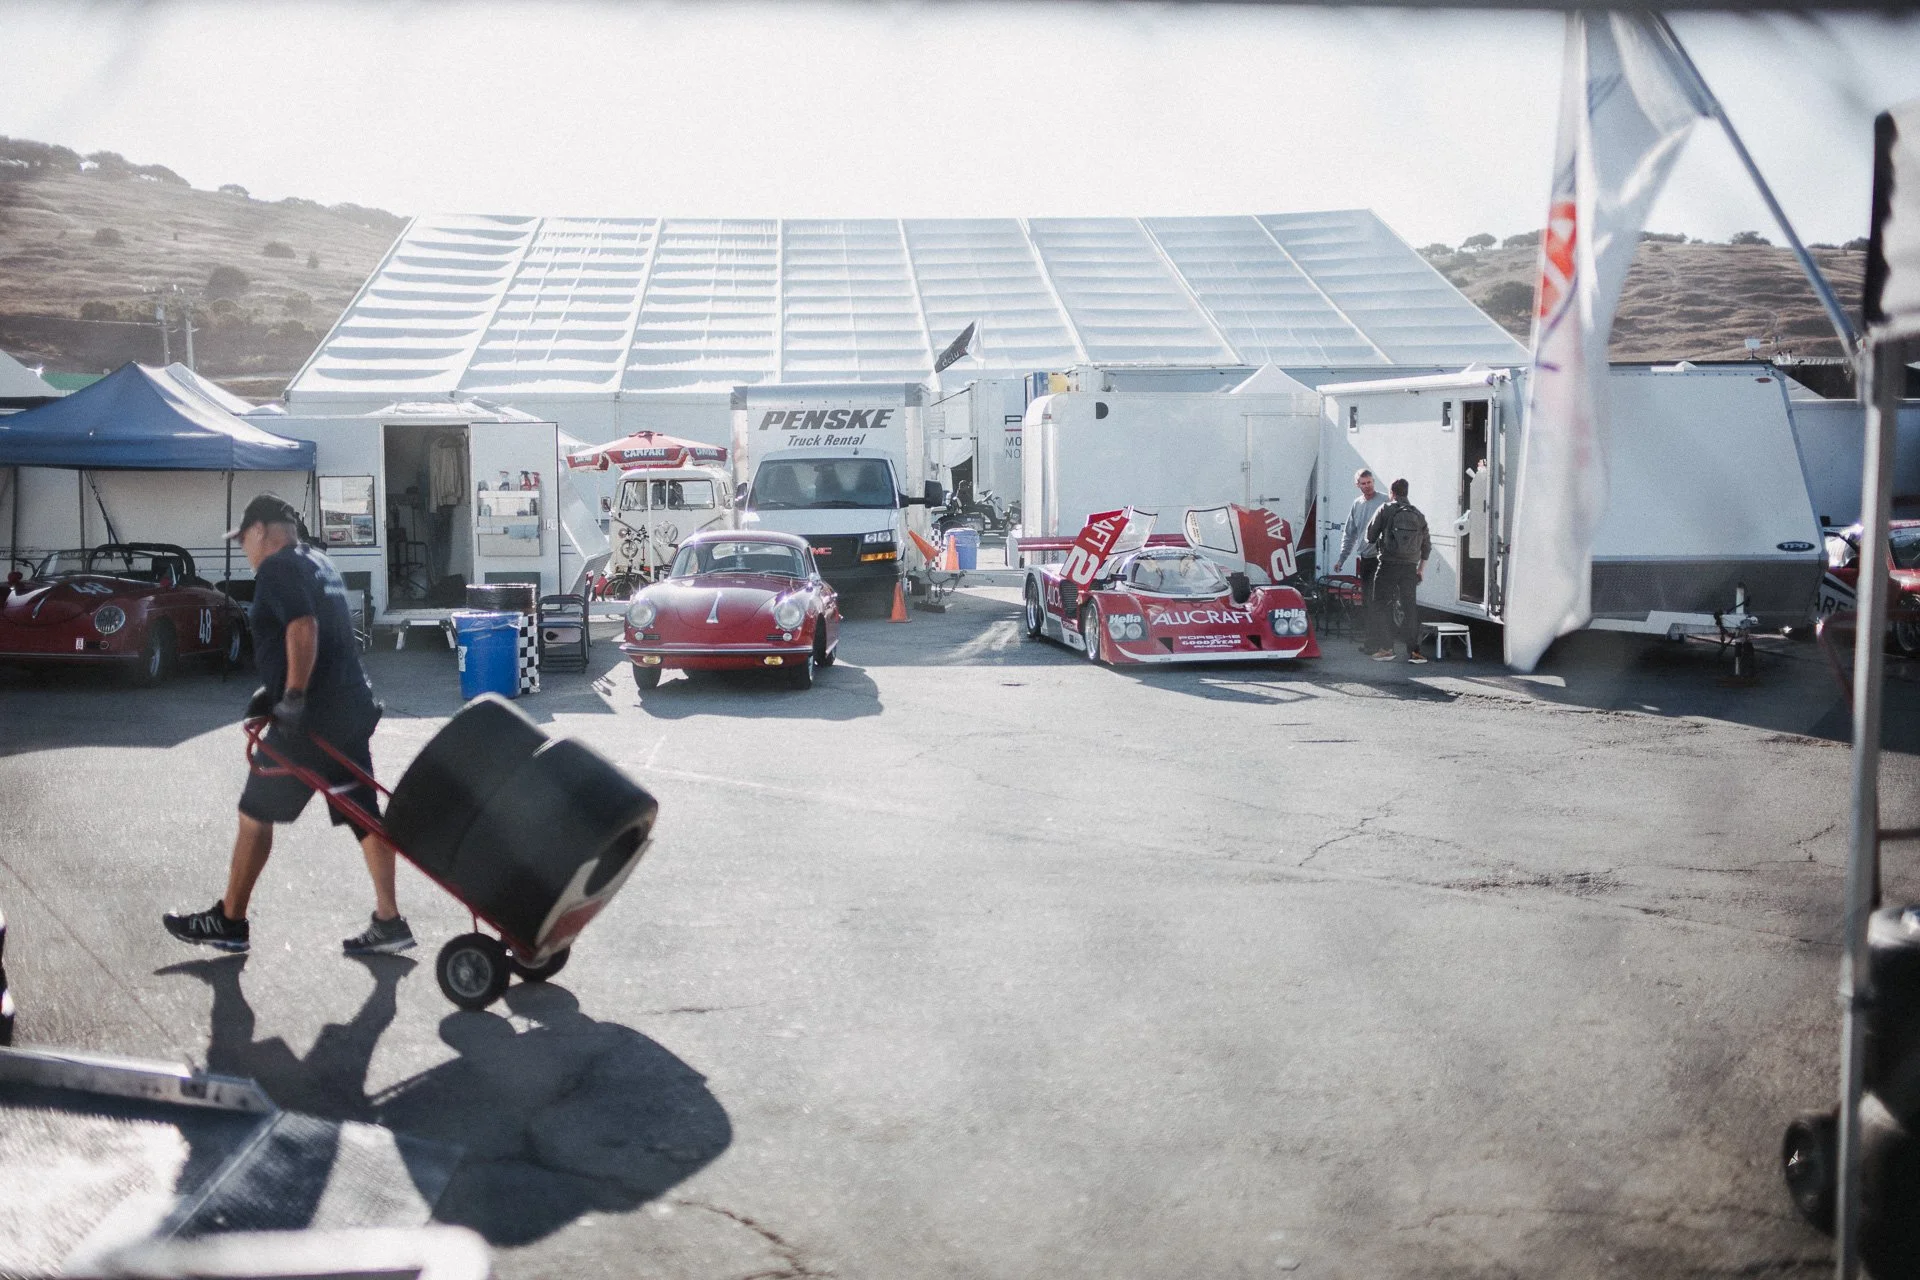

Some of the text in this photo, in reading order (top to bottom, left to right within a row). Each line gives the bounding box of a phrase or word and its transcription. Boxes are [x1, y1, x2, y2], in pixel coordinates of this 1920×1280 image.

[759, 408, 895, 431] PENSKE
[787, 433, 867, 447] Truck Rental
[624, 449, 665, 458] CAMPARI
[811, 547, 832, 555] MC
[1060, 545, 1100, 584] 2
[1271, 543, 1297, 581] 2
[70, 581, 114, 595] 48
[1109, 613, 1142, 624] Hella
[1152, 610, 1254, 626] ALUCRAFT
[1274, 608, 1306, 619] Hella
[199, 608, 212, 644] 48
